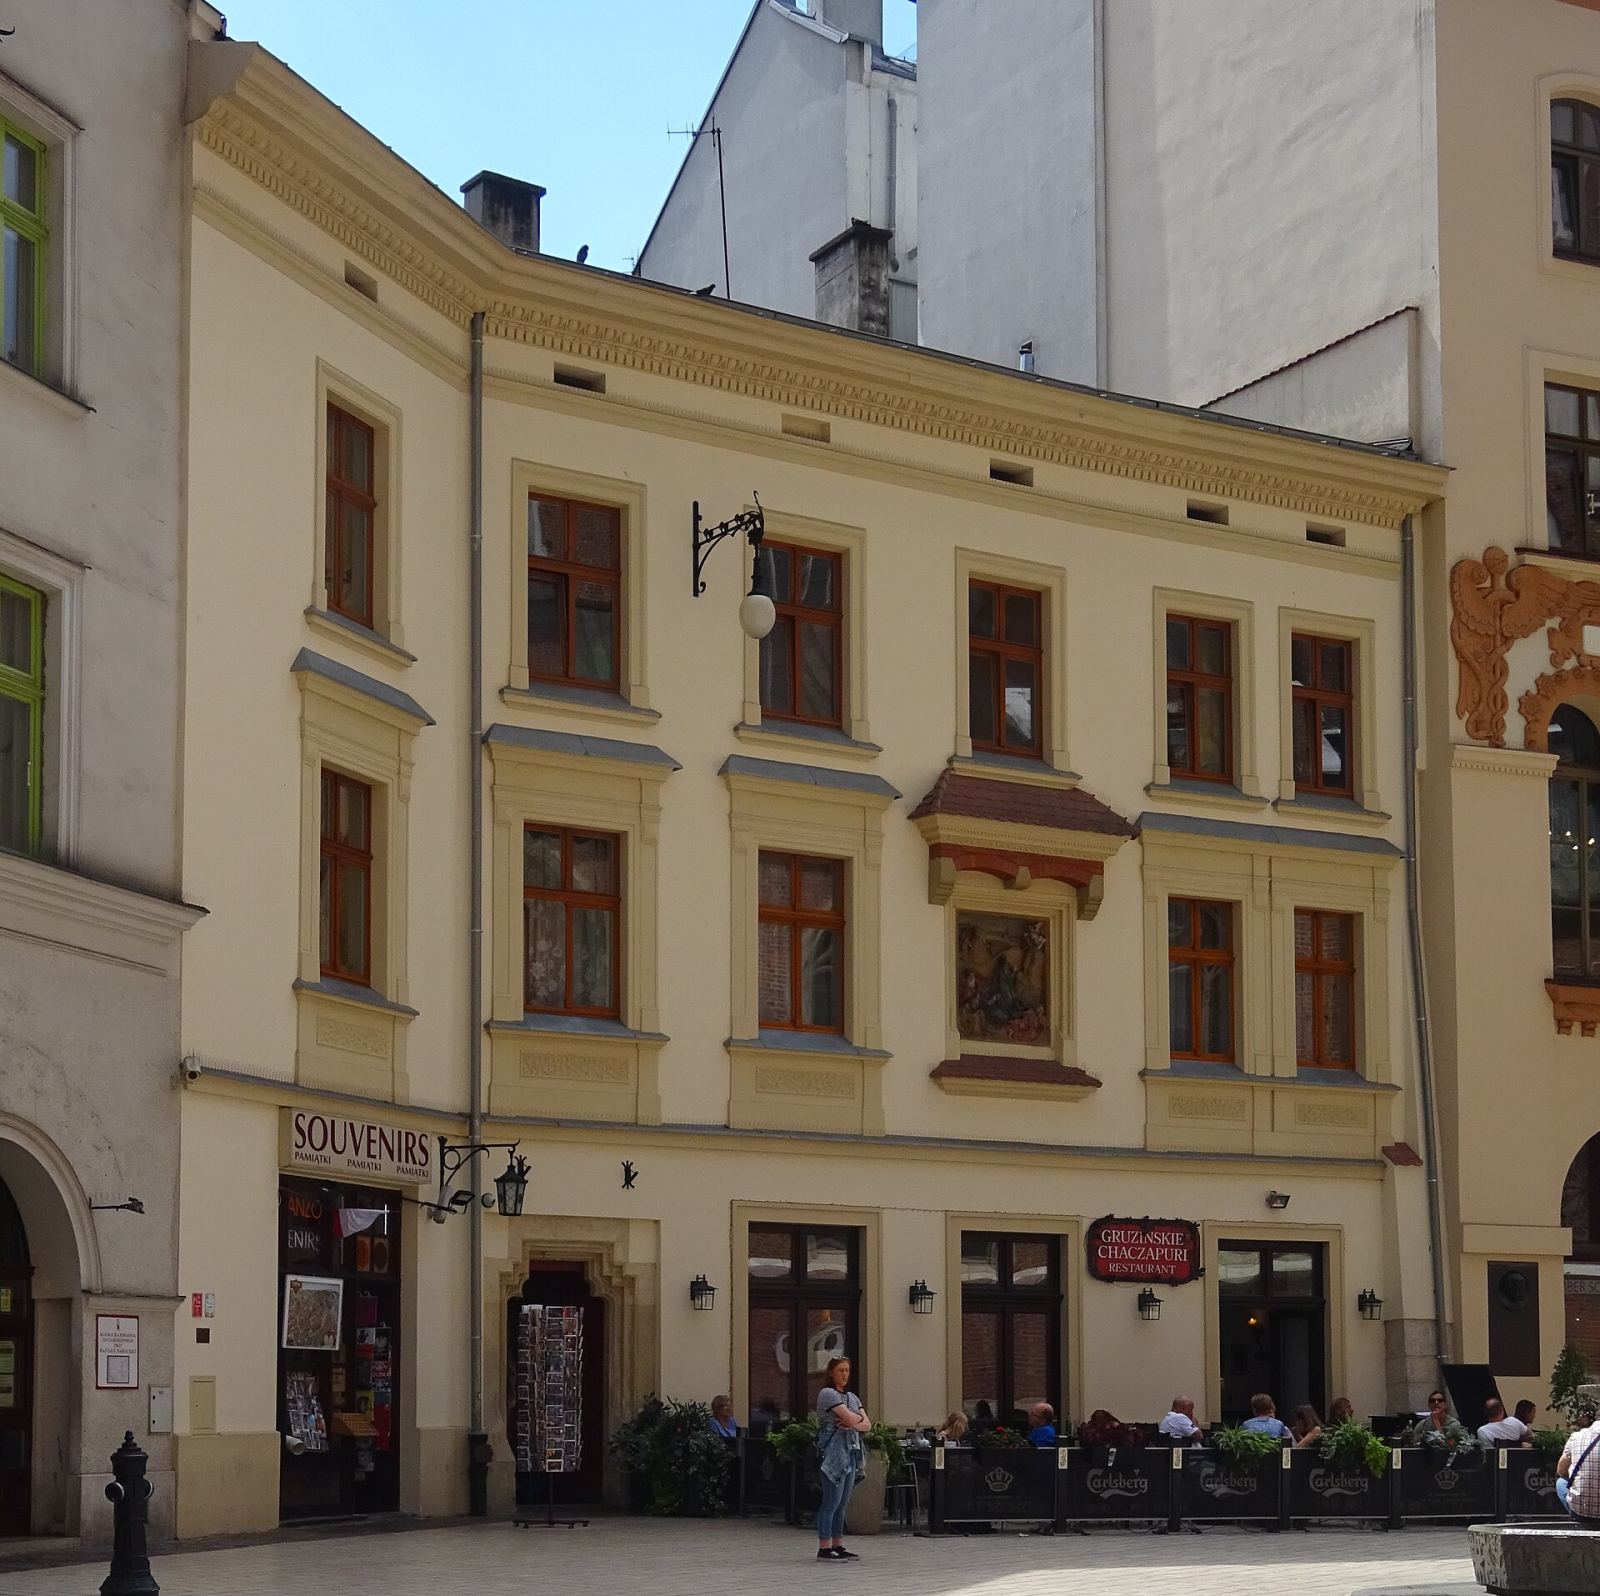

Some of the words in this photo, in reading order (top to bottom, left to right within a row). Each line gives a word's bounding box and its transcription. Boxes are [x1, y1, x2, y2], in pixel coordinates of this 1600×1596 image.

[294, 1113, 429, 1166] SOUVENIRS
[294, 1151, 331, 1165] PAMIĄTKI
[1098, 1245, 1188, 1262] CHACZAPURI
[1109, 1262, 1177, 1275] RESTAURANT
[1087, 1468, 1148, 1494] Carlsberg
[1200, 1467, 1257, 1492] Carlsberg
[1309, 1468, 1369, 1492] Carlsberg
[1524, 1468, 1556, 1492] Carls
